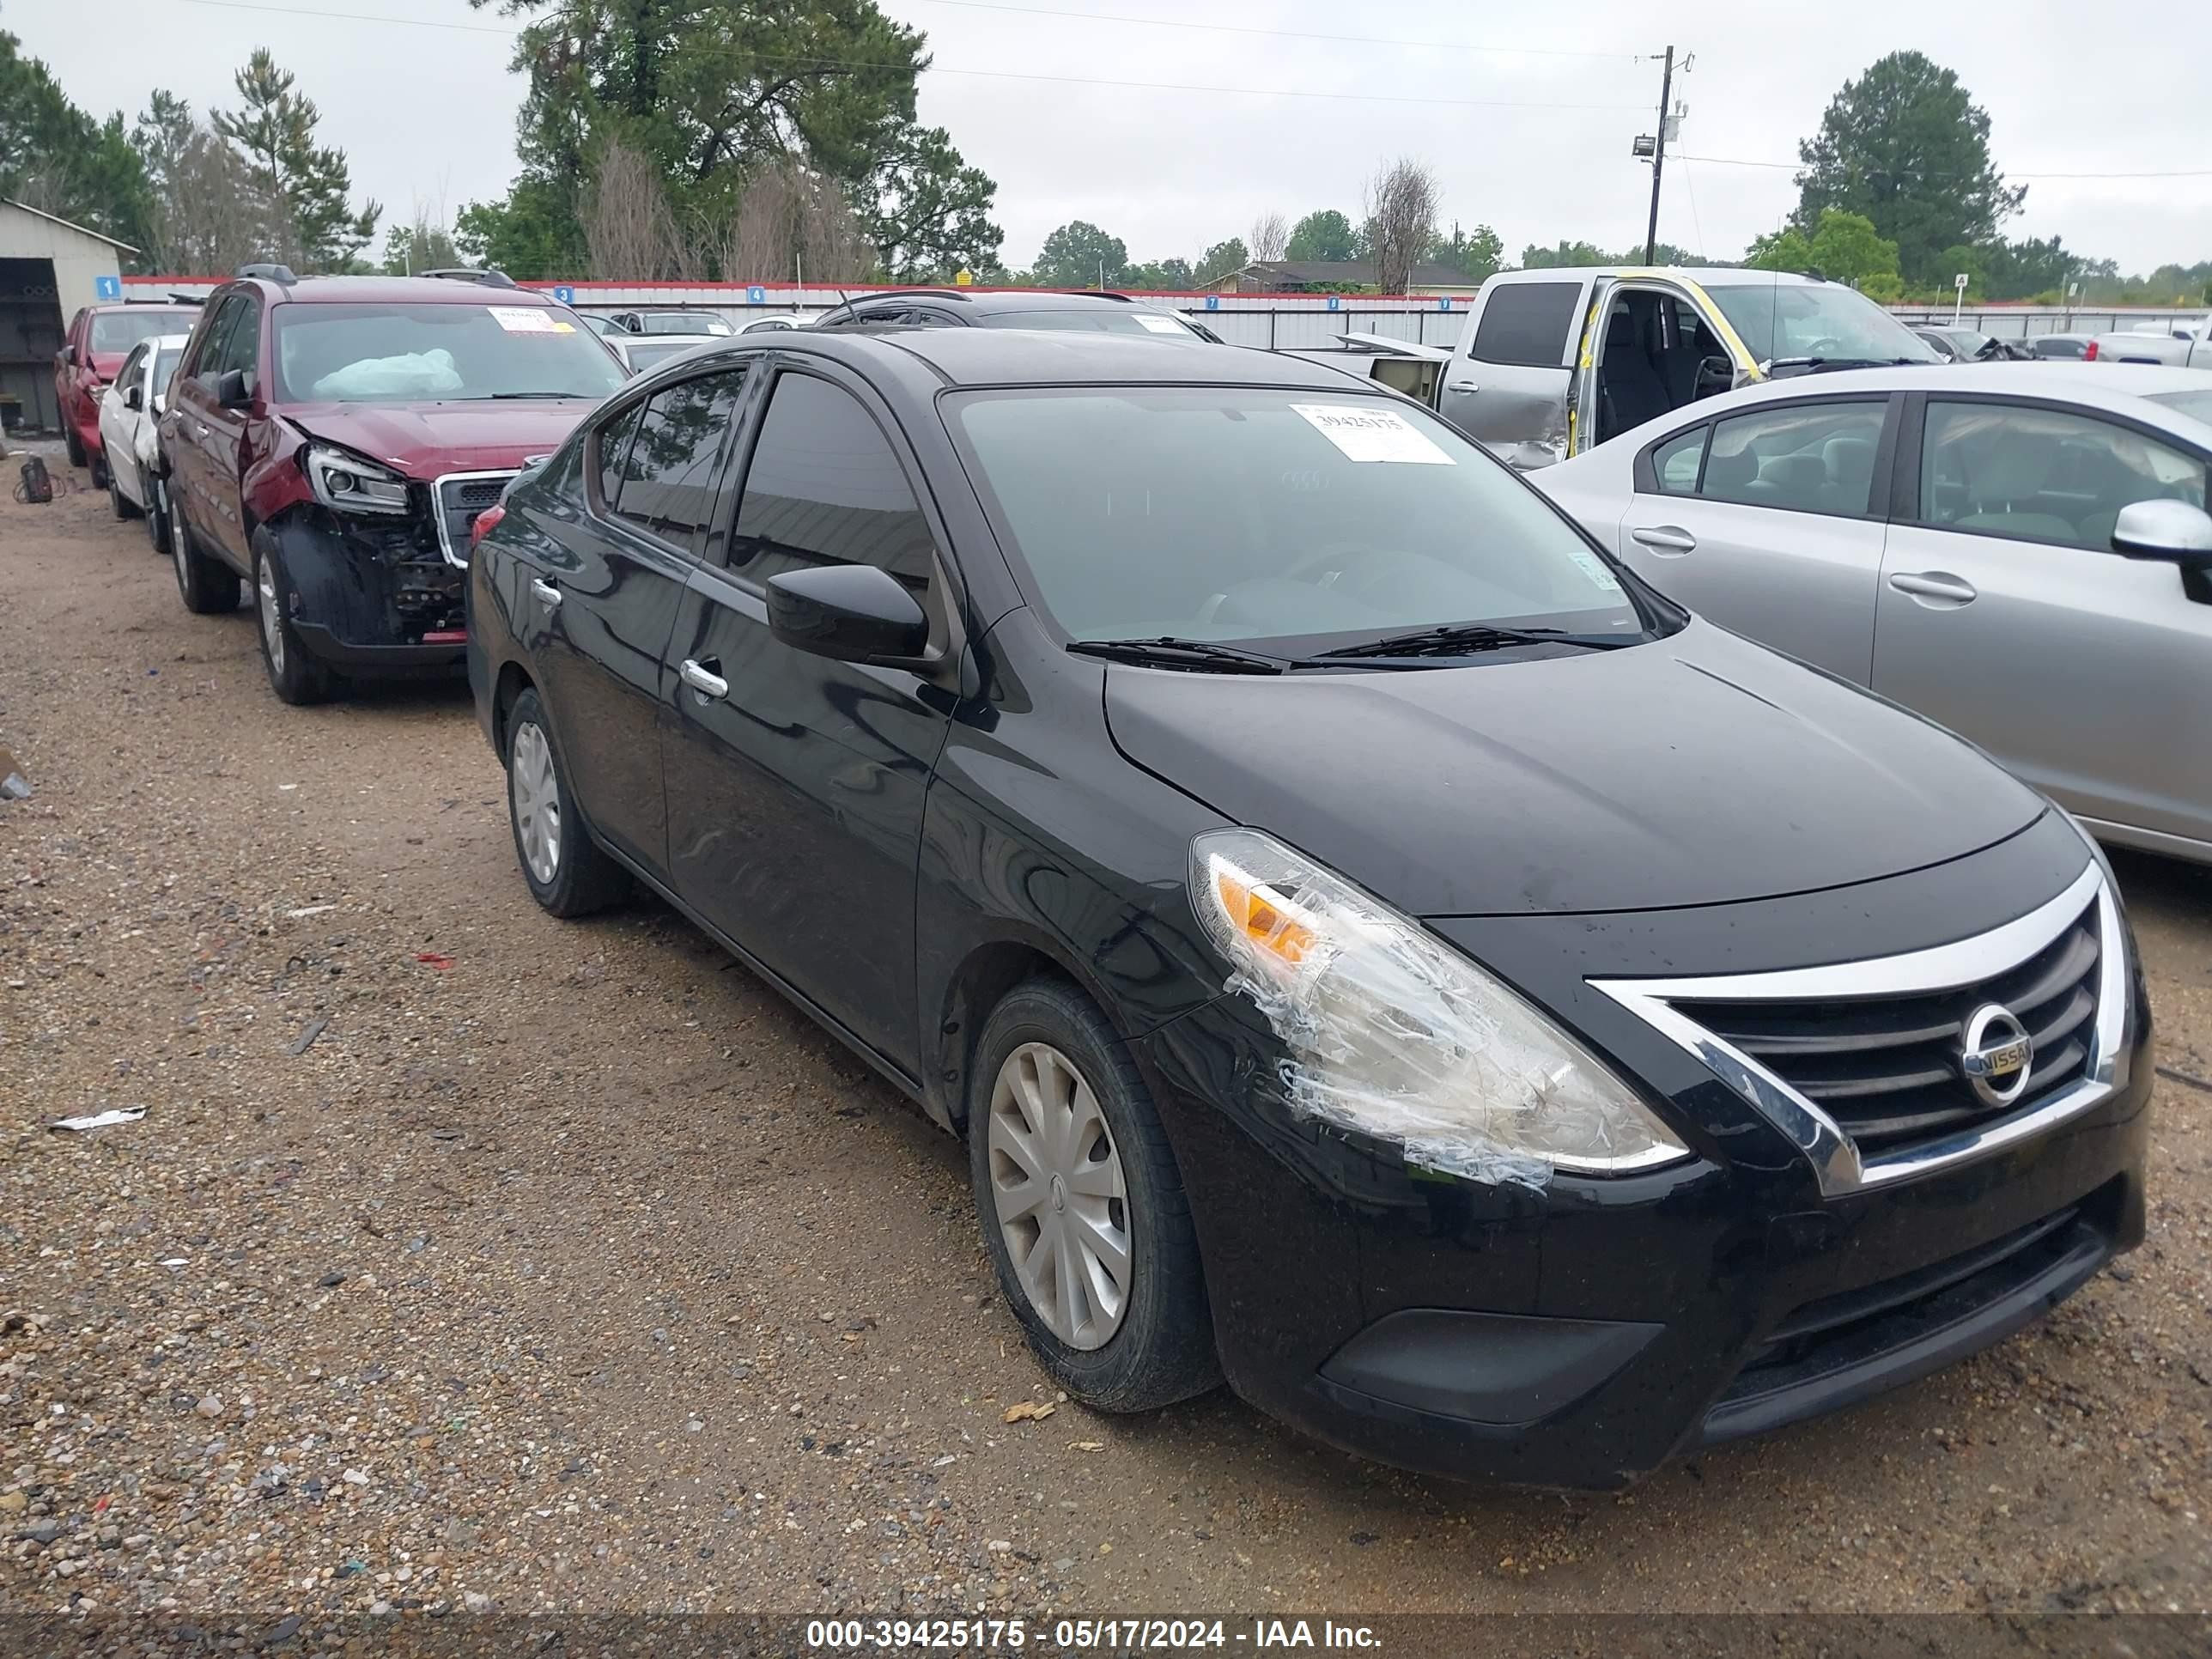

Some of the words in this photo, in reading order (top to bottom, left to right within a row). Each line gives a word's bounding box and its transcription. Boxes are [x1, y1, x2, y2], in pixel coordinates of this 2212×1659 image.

[104, 280, 112, 295] 1
[560, 289, 568, 301] 3
[753, 289, 761, 301] 4
[1210, 298, 1216, 307] 7
[1331, 299, 1337, 308] 8
[1443, 299, 1448, 308] 9
[1316, 415, 1403, 430] 39425175
